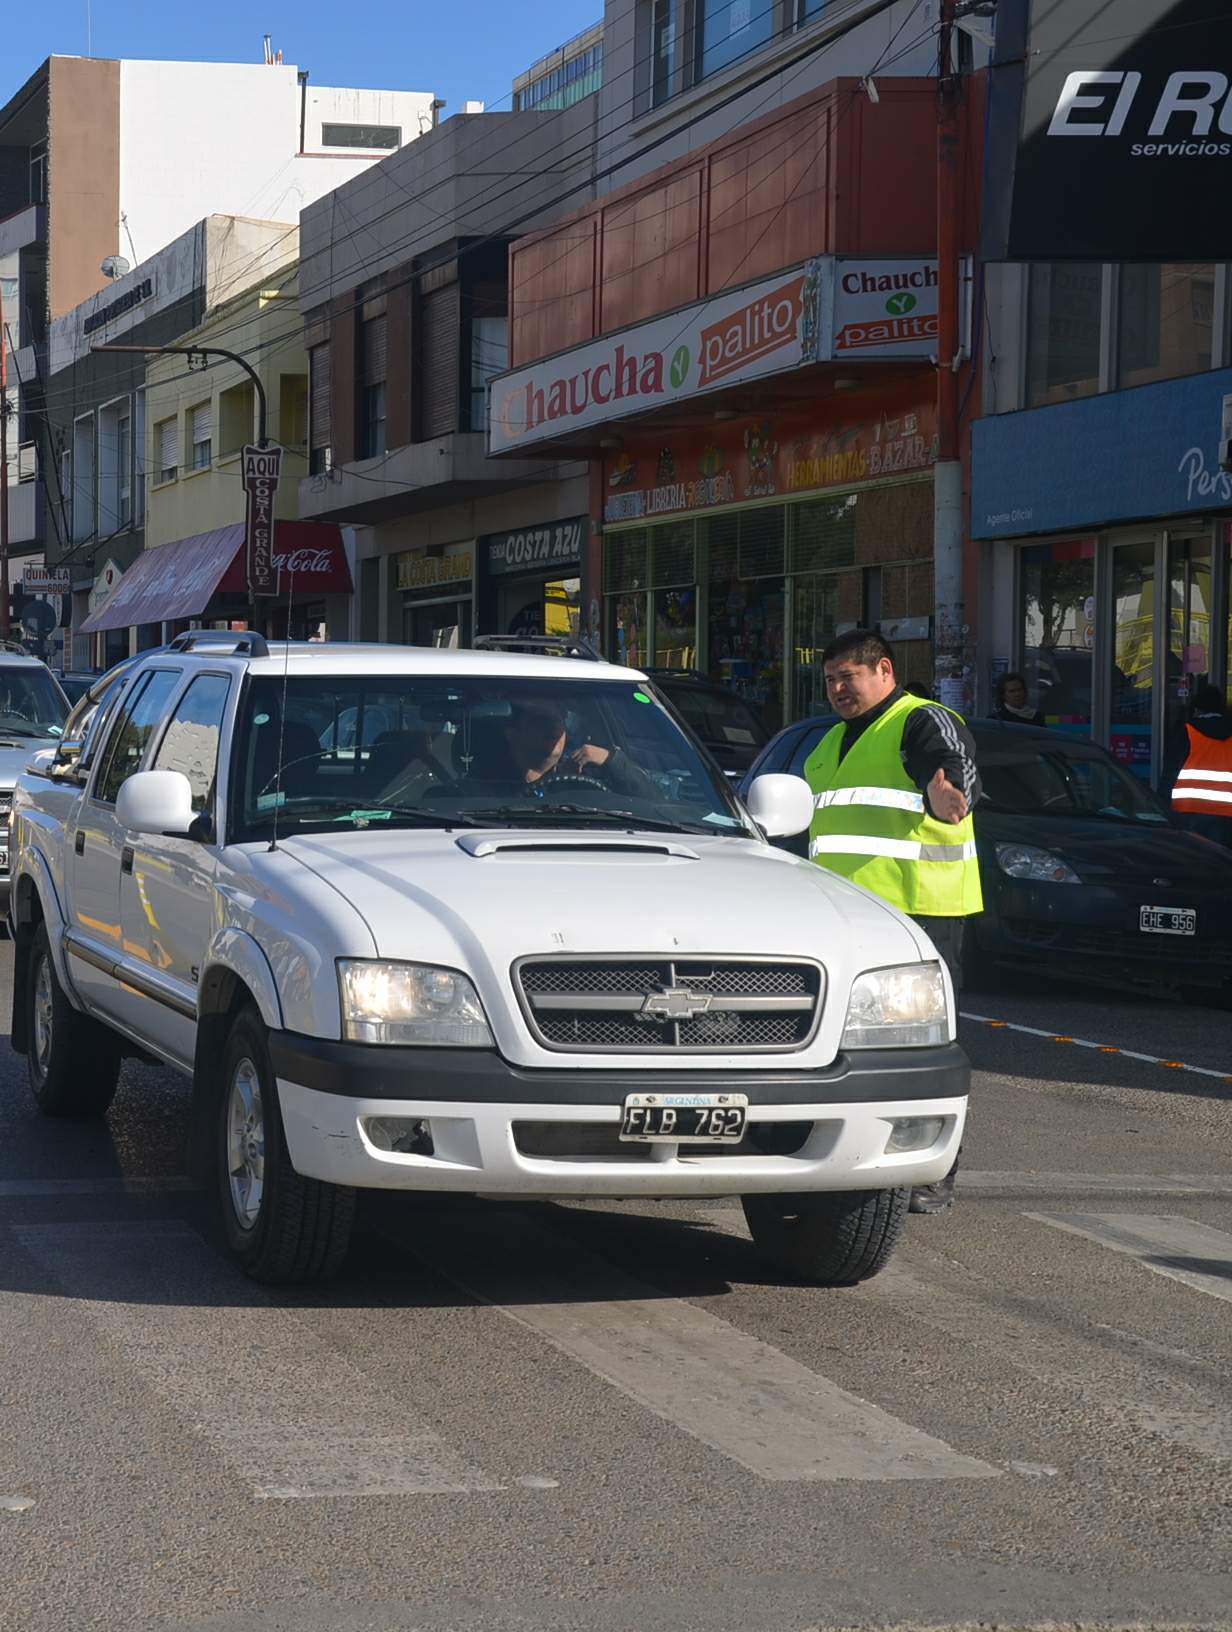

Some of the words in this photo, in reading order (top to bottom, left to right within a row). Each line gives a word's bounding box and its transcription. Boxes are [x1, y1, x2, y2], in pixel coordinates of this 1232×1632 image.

[1047, 71, 1142, 136] El
[1130, 140, 1230, 156] servicios
[842, 265, 938, 294] Chauch
[502, 345, 665, 438] Chaucha
[706, 299, 794, 378] palito
[246, 456, 280, 476] AQUI
[1178, 447, 1232, 501] Pers
[255, 478, 269, 524] COSTA
[255, 529, 269, 586] GRANDE
[506, 530, 551, 564] COSTA
[553, 523, 581, 556] AZU
[1142, 912, 1164, 928] EHE
[1171, 915, 1193, 930] 956
[626, 1108, 677, 1134] FLB
[694, 1108, 742, 1135] 762
